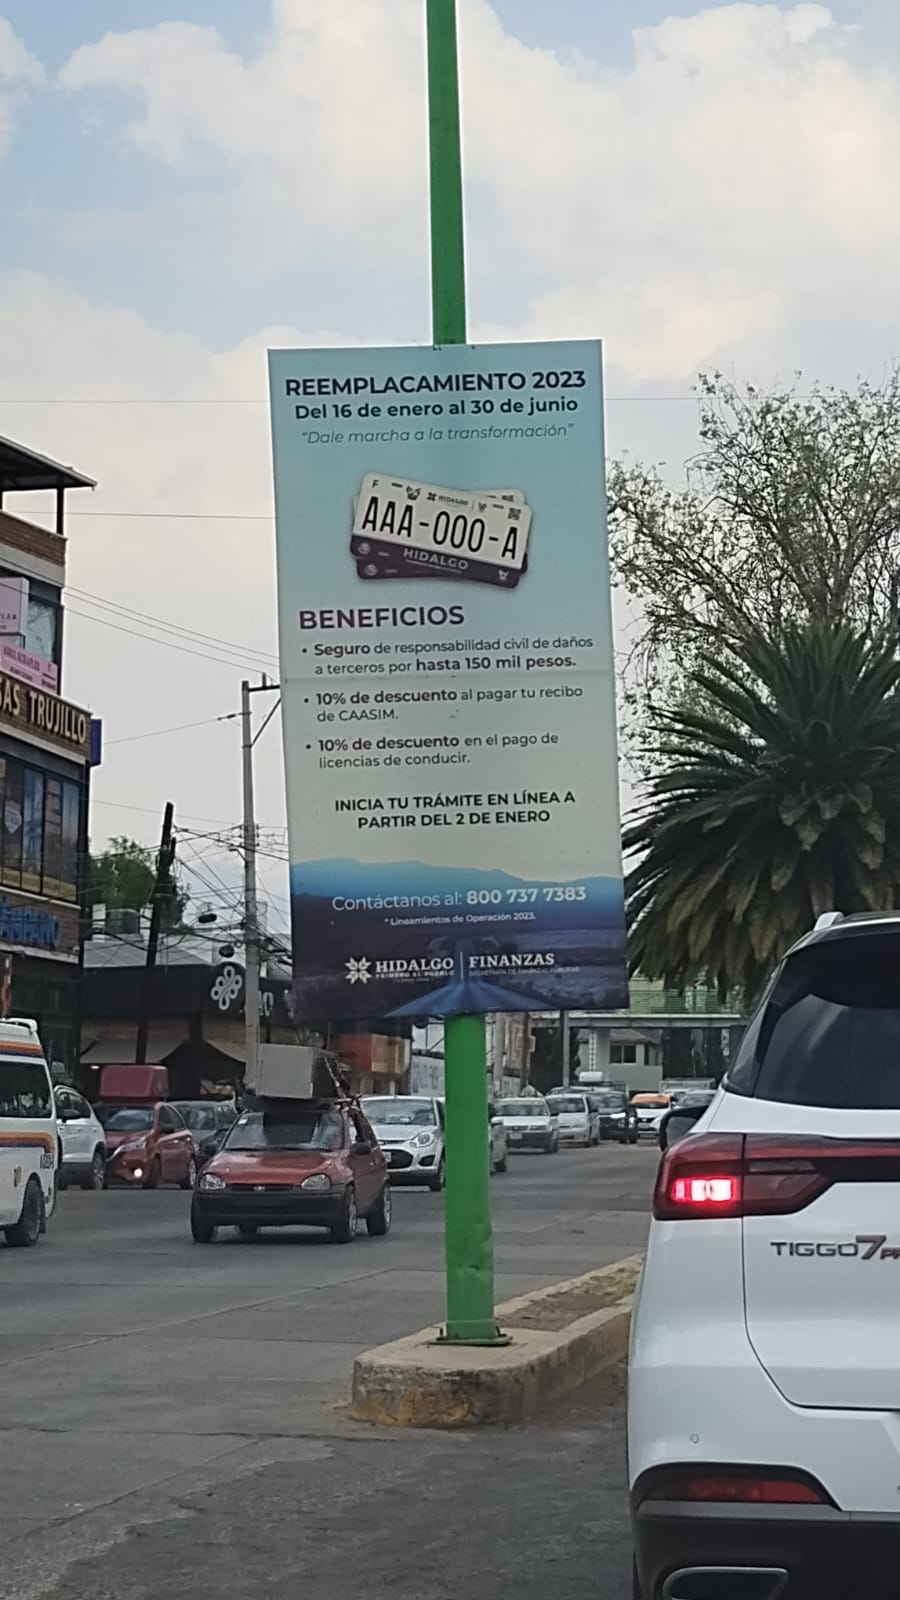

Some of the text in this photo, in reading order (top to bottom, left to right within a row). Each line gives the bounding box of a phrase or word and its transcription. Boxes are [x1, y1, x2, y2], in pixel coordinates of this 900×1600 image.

[286, 371, 585, 395] REEMPLACAMIENTO 2023
[296, 396, 577, 419] Del 16 de enero al 30 de junio
[349, 429, 410, 442] marcha
[415, 431, 424, 440] a
[429, 428, 443, 440] la
[372, 479, 379, 488] F
[361, 495, 518, 560] AAA-000-A
[403, 548, 469, 570] HIDALGO
[300, 606, 464, 629] BENEFICIOS
[315, 637, 593, 658] Seguro de responsabilidad civil de daños
[315, 655, 576, 674] a terceros por hasta 150 mil pesos.
[316, 686, 582, 705] 10% de descuento al pagar tu recibo
[0, 677, 87, 744] AS TRUJILLO
[317, 709, 398, 722] de CAASIM.
[318, 733, 558, 751] 10% de descuento en el pago de
[320, 752, 470, 768] licencias de conducir.
[336, 790, 575, 811] INICIA TU TRÁMITE EN LÍNEA A
[358, 810, 550, 828] PARTIR DEL 2 DE ENERO
[332, 886, 586, 911] Contáctanos al: 800 737 7383
[466, 913, 511, 922] Operación
[376, 958, 453, 972] HIDALGO
[470, 953, 554, 968] FINANZAS
